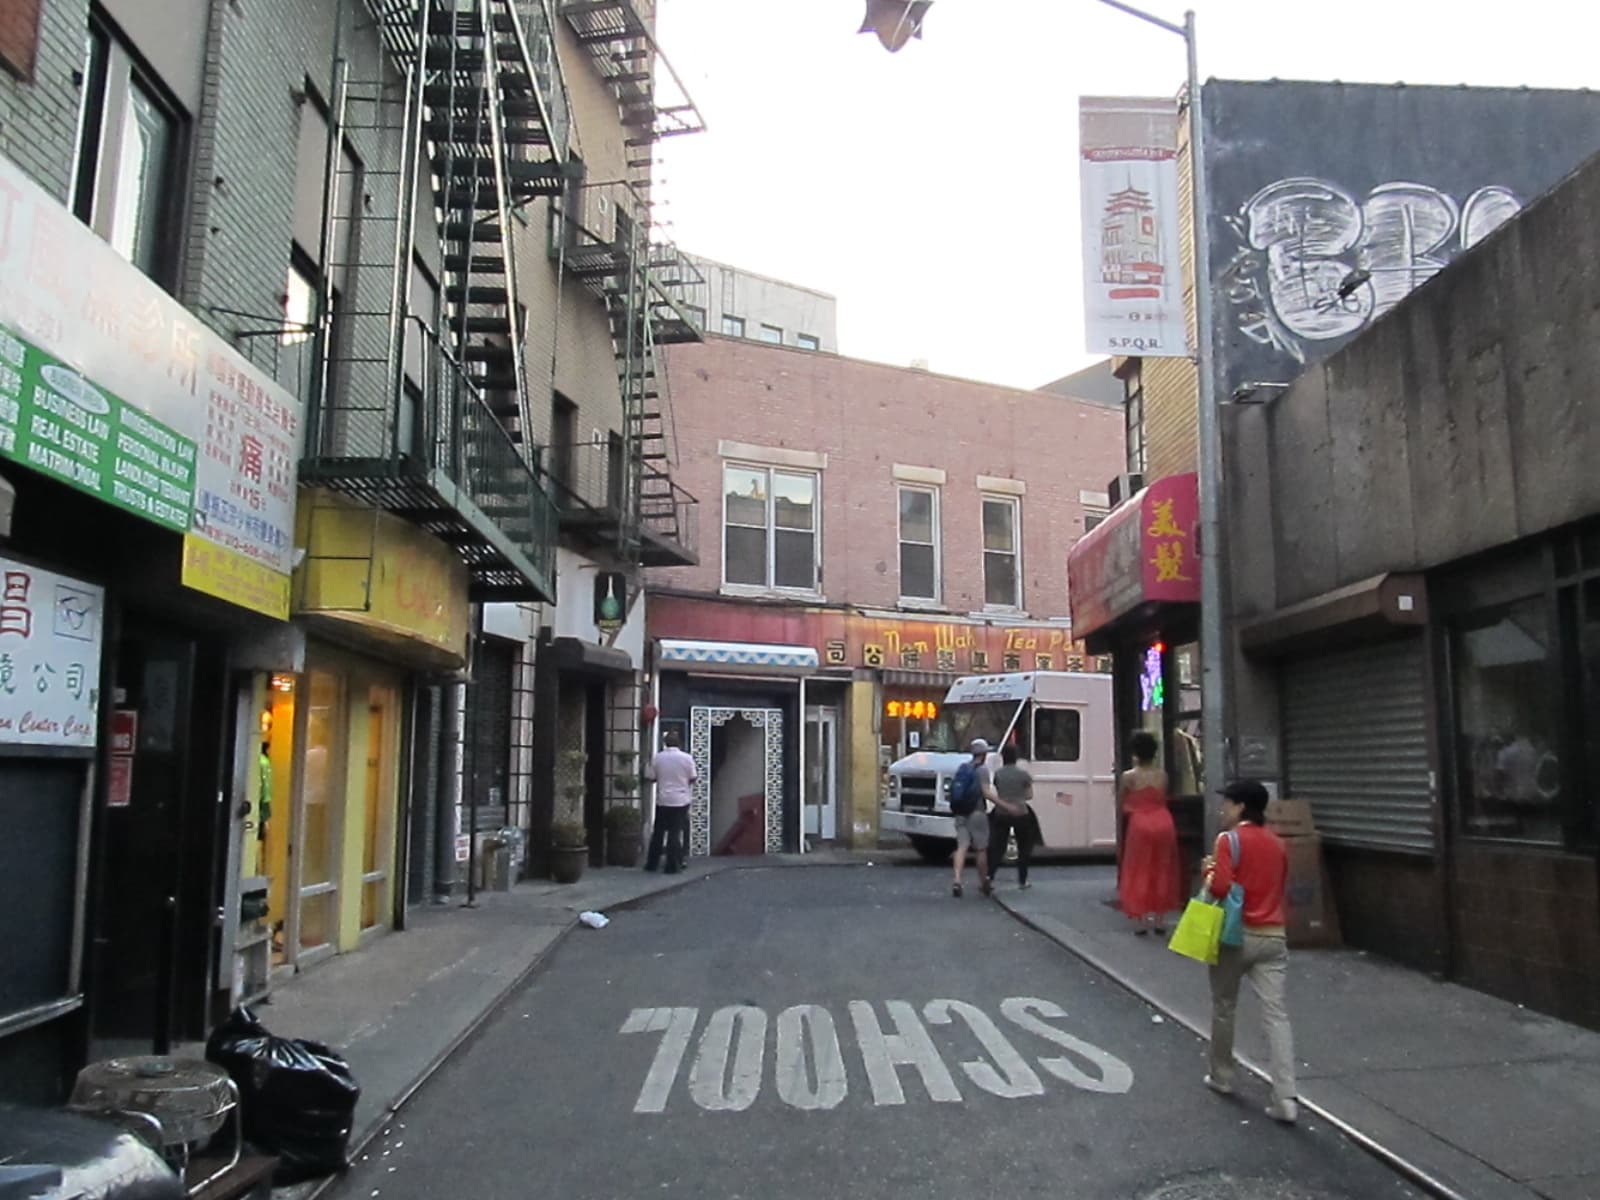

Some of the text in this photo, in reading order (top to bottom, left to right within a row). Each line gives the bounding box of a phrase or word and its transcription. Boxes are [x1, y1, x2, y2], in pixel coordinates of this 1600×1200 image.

[31, 415, 60, 445] REAL
[63, 430, 99, 464] ESTATE
[934, 625, 976, 649] Wah
[1003, 629, 1036, 651] Tea
[619, 997, 1134, 1112] SCHOOL
